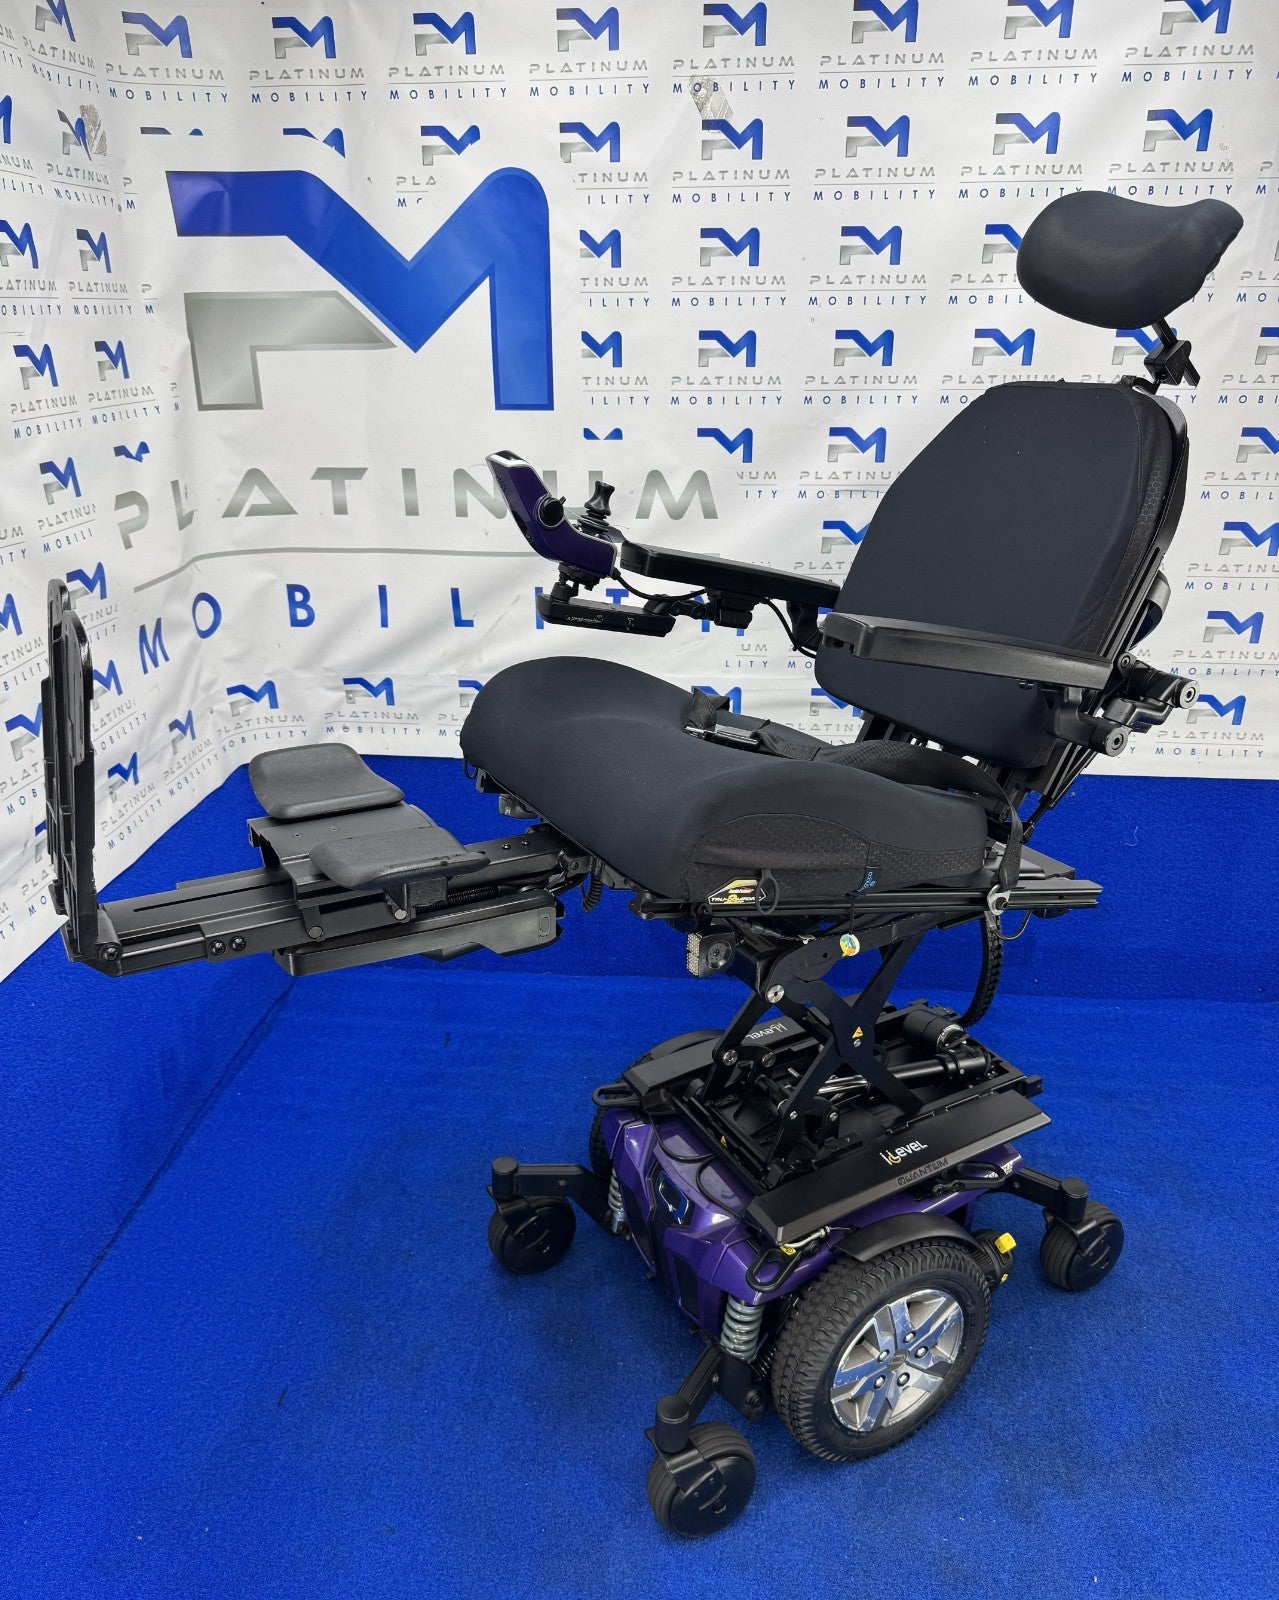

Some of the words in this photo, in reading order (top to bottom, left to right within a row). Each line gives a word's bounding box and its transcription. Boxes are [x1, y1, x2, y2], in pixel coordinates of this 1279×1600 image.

[23, 36, 95, 69] PLATINUM
[970, 48, 1099, 63] PLATINUM
[1125, 44, 1254, 58] PLATINUM
[673, 56, 795, 70] PLATINUM
[820, 52, 945, 66] PLATINUM
[106, 63, 224, 81] PLATINUM
[388, 64, 505, 77] PLATINUM
[529, 59, 648, 74] PLATINUM
[32, 63, 100, 94] MOBILITY
[249, 68, 365, 80] PLATINUM
[968, 72, 1099, 87] MOBILITY
[1122, 69, 1252, 82] MOBILITY
[673, 79, 796, 94] MOBILITY
[818, 76, 945, 90] MOBILITY
[110, 87, 229, 103] MOBILITY
[389, 87, 507, 100] MOBILITY
[529, 83, 650, 97] MOBILITY
[252, 92, 367, 103] MOBILITY
[47, 162, 109, 185] PLATINUM
[814, 166, 935, 180] PLATINUM
[961, 164, 1083, 176] PLATINUM
[1109, 161, 1234, 174] PLATINUM
[572, 171, 648, 183] TINUM
[672, 169, 790, 182] PLATINUM
[813, 188, 936, 201] MOBILITY
[1106, 184, 1233, 196] MOBILITY
[54, 188, 114, 207] MOBILITY
[672, 191, 791, 204] MOBILITY
[671, 275, 786, 286] PLATINUM
[809, 274, 927, 285] PLATINUM
[69, 281, 128, 293] PLATINUM
[671, 296, 786, 307] MOBILITY
[808, 295, 927, 306] MOBILITY
[948, 295, 1037, 304] MOBIL
[74, 305, 133, 315] MOBILITY
[670, 375, 782, 386] PLATINUM
[804, 374, 918, 386] PLATINUM
[941, 375, 1056, 384] PLATINUM
[88, 386, 154, 403] PLATINUM
[670, 396, 782, 405] MOBILITY
[804, 395, 918, 405] MOBILITY
[11, 395, 78, 414] PLATINUM
[92, 405, 161, 424] MOBILITY
[14, 417, 82, 439] MOBILITY
[799, 470, 902, 480] PLATINU
[1185, 582, 1279, 591] MOBILI
[1172, 650, 1279, 660] PLATINUM
[1170, 668, 1279, 676] MOBILITY
[325, 711, 419, 720] PLATINUM
[218, 716, 304, 737] PLATINUM
[326, 725, 421, 736] MOBILITY
[94, 712, 148, 756] OBILITY
[1157, 730, 1264, 741] PLATINUM
[163, 738, 212, 780] PLATINUM
[1155, 747, 1263, 758] MOBILITY
[169, 753, 219, 796] MOBILITY
[101, 782, 156, 831] PLATINUM
[108, 800, 162, 850] MOBILITY
[896, 1157, 949, 1187] QUANTUM
